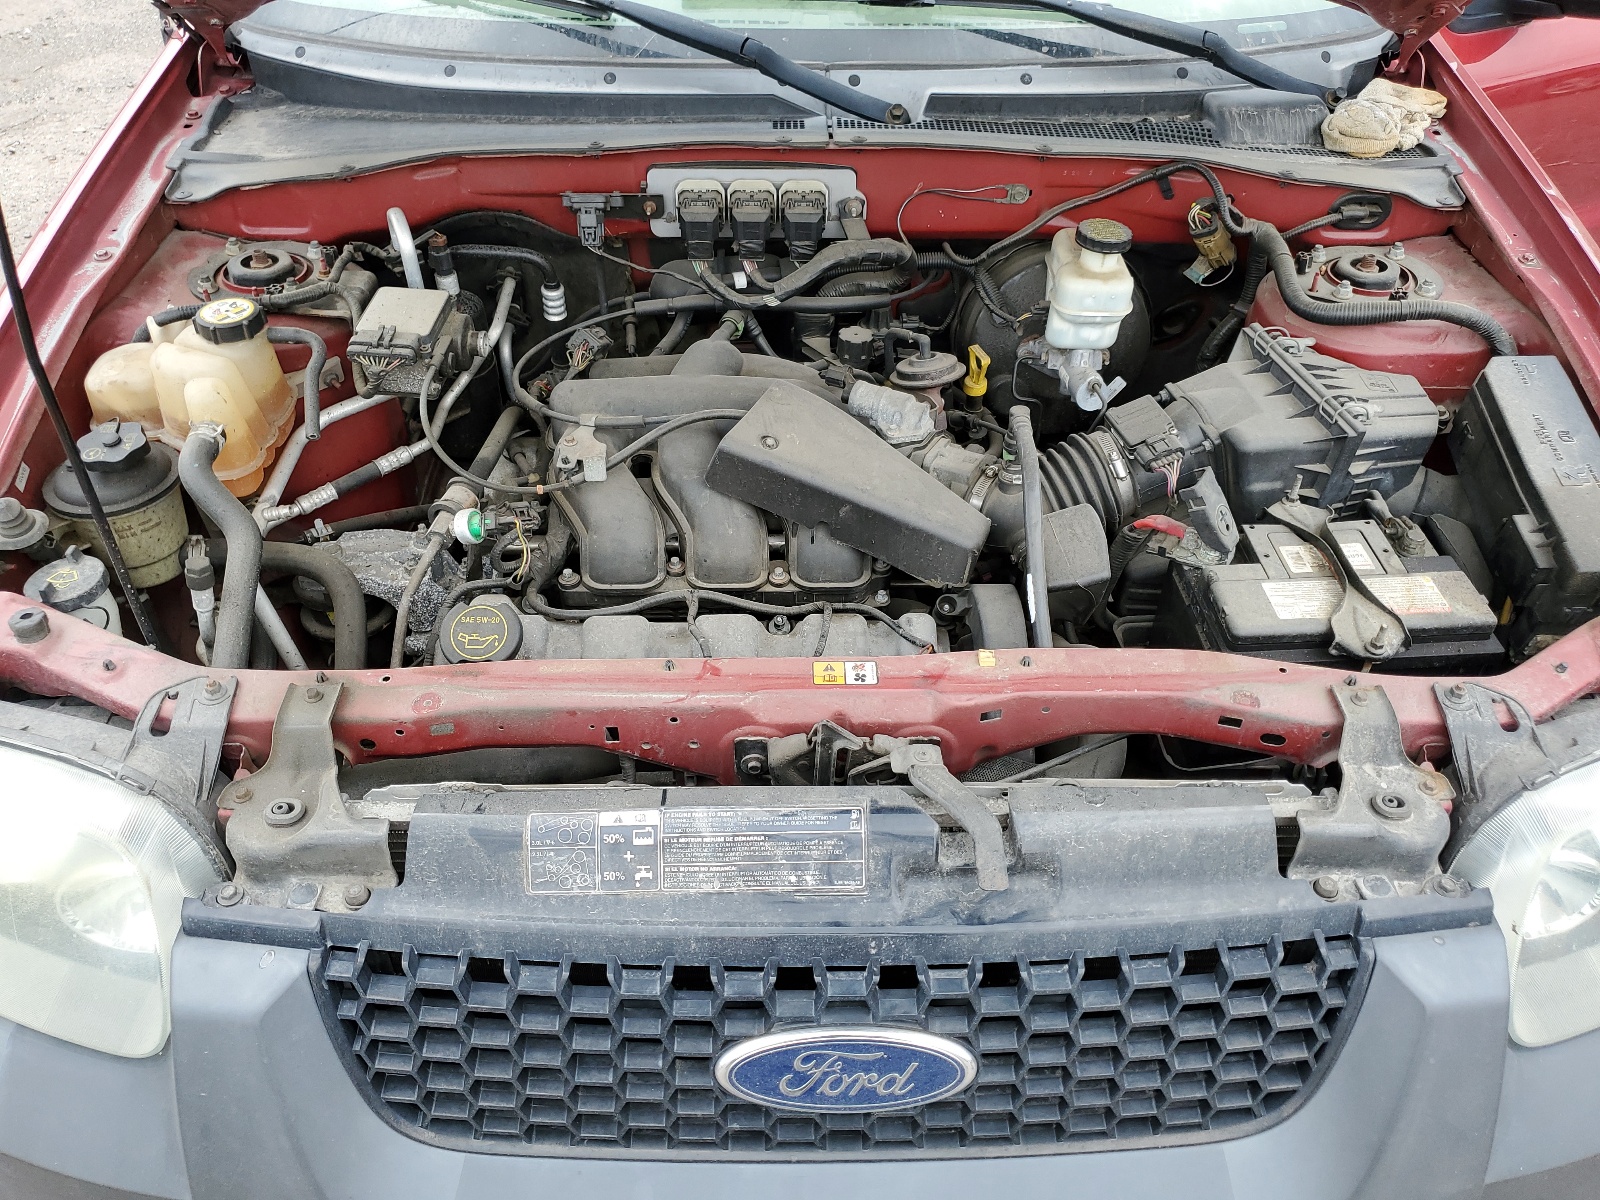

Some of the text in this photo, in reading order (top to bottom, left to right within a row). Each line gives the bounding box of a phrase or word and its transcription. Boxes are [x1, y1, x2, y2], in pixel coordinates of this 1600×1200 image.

[476, 616, 500, 624] 5W-20
[603, 834, 625, 844] 50%
[603, 871, 625, 881] 50%
[779, 1050, 919, 1097] Ford
